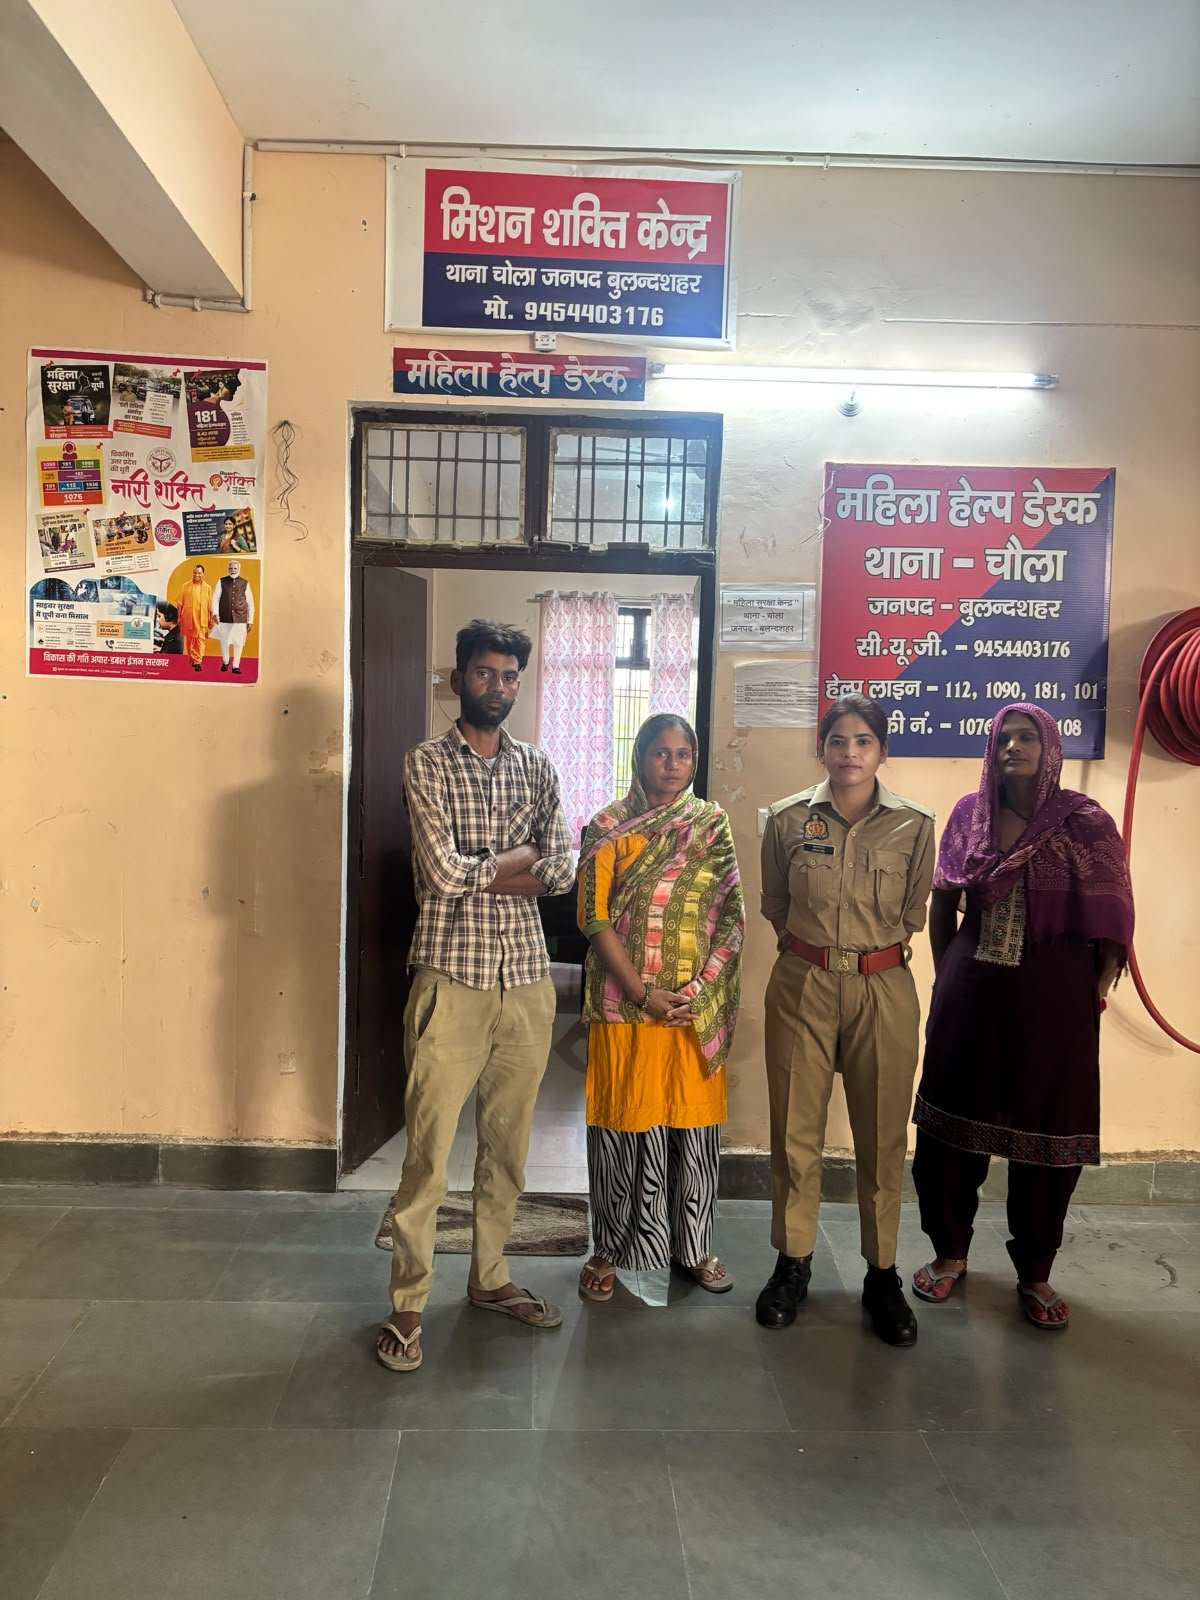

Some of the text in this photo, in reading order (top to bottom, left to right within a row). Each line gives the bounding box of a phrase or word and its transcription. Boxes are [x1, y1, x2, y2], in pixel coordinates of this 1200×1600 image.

[440, 186, 711, 260] मिशन शक्ति केन्द्र
[445, 260, 702, 300] थाना चोला जनपद बुलन्दशहर
[483, 295, 664, 327] मो. 9454403176
[47, 368, 78, 380] महिला
[405, 351, 493, 393] महिला
[564, 356, 631, 395] डेस्क
[46, 381, 75, 393] सुरक्षा
[194, 410, 217, 423] 181
[111, 450, 134, 458] विकसित
[110, 468, 216, 512] नारी शक्ति
[835, 472, 1102, 528] महिला हेल्प डेस्क
[864, 546, 945, 580] थाना
[984, 532, 1068, 583] चौला
[35, 602, 75, 612] साइबर सुरक्षा
[733, 597, 754, 607] महिला
[757, 599, 776, 609] सुरक्षा
[777, 597, 793, 607] केन्द्र
[866, 597, 936, 617] जनपद
[958, 598, 1062, 627] बुलन्दशहर
[42, 611, 54, 620] यूपी
[68, 612, 89, 620] मिसाल
[743, 612, 761, 620] थाना
[730, 625, 753, 633] जनपद
[759, 625, 795, 635] बुलन्दशहर
[855, 629, 948, 667] सी.यू.जी.
[973, 639, 1071, 658] 9454403176
[43, 652, 170, 668] विकास की गति अपार-डबल इंजन सरकार
[867, 679, 922, 701] लाइन
[944, 680, 978, 700] 112,
[985, 681, 1027, 701] 1090,
[1033, 681, 1067, 701] 181,
[1073, 682, 1098, 700] 101
[909, 710, 933, 735] नं.
